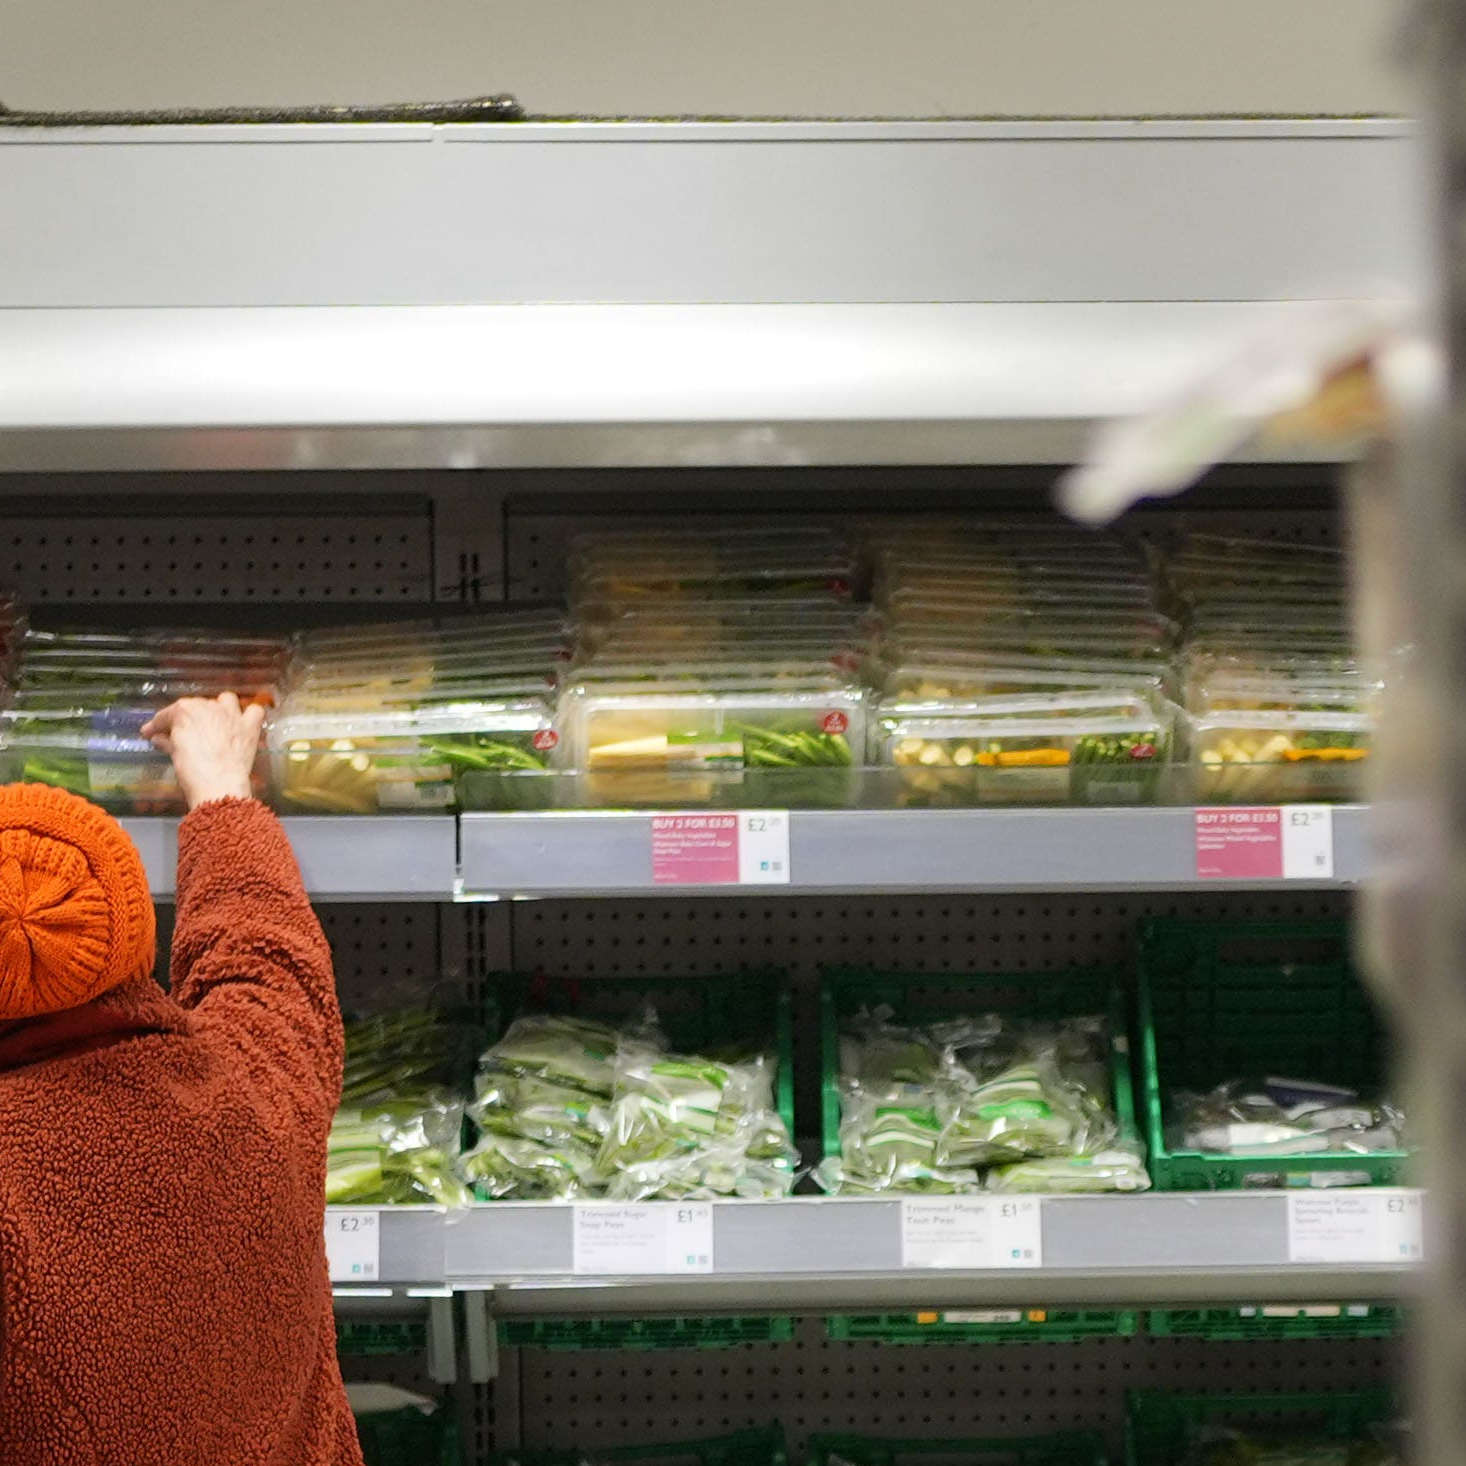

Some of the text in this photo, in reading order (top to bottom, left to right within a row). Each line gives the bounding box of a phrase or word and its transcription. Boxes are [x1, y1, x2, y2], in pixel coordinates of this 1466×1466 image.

[652, 818, 675, 829] BUY
[685, 818, 707, 829] FOR
[1197, 813, 1217, 824] BUY
[1229, 813, 1249, 824] FOR
